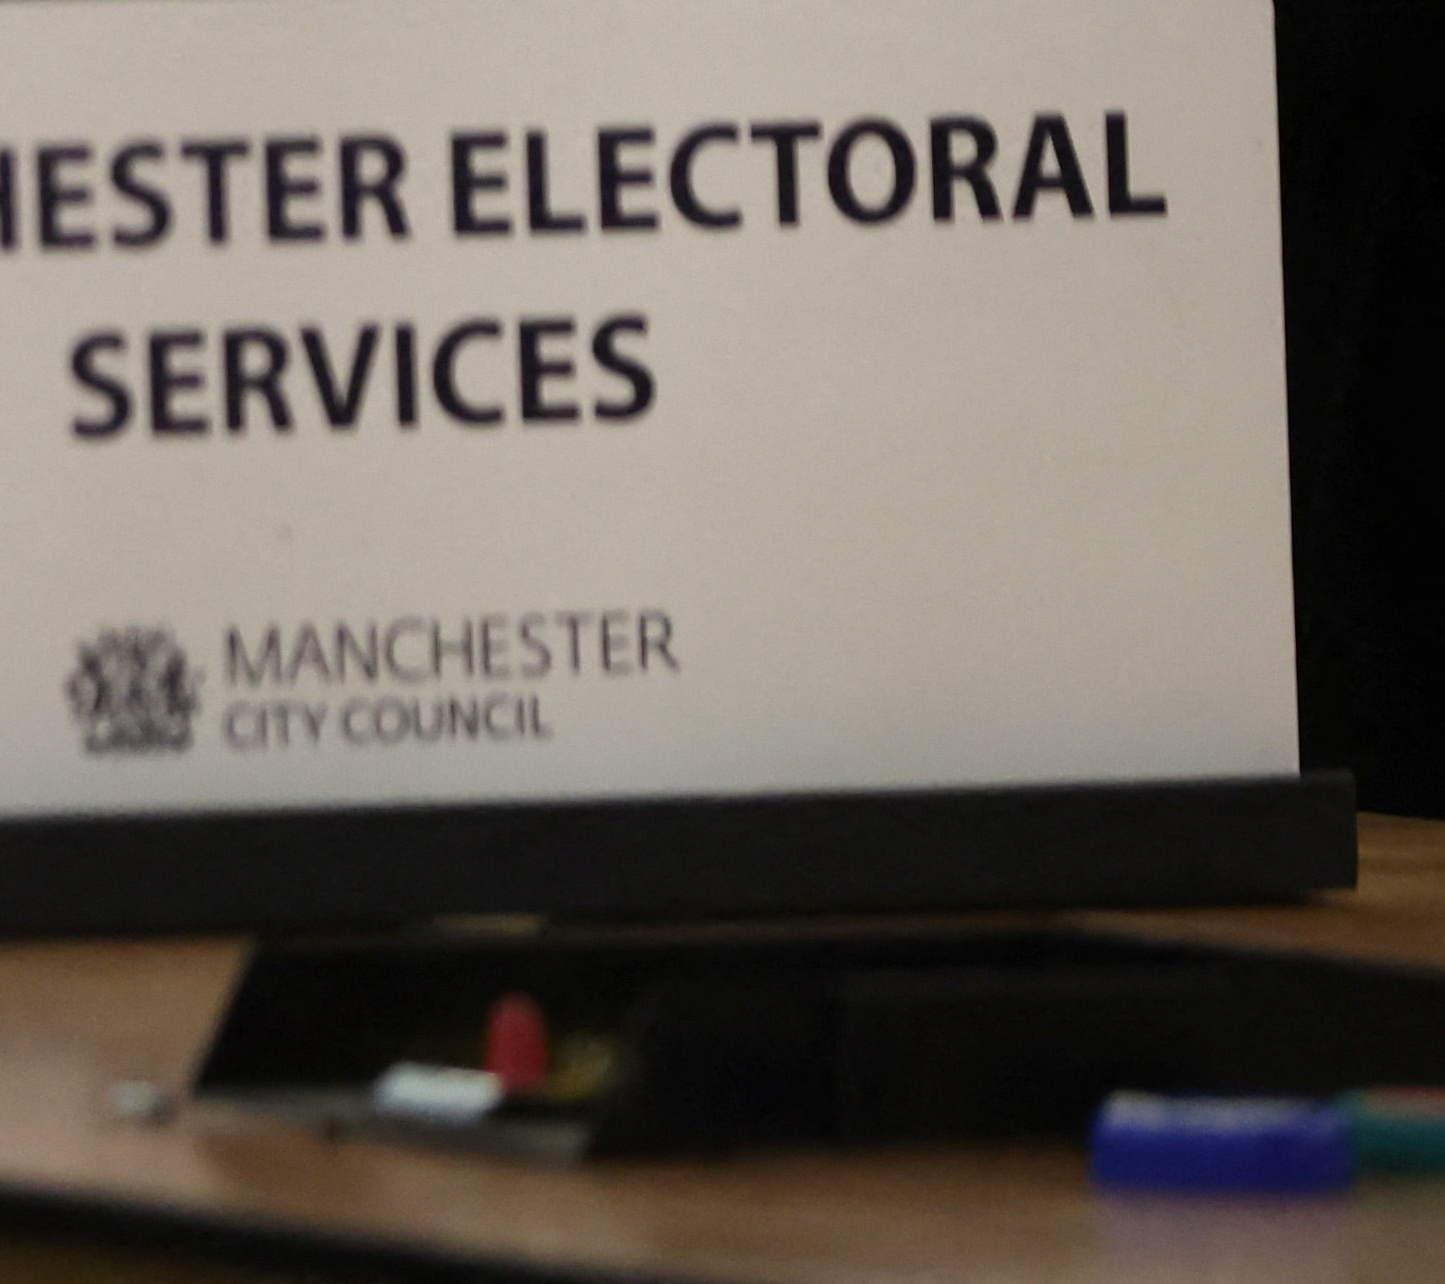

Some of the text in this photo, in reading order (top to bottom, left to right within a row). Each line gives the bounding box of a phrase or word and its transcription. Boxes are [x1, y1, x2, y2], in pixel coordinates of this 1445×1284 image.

[449, 110, 1168, 239] ELECTORAL
[68, 313, 658, 442] SERVICES
[223, 611, 681, 689] MANCHESTER
[223, 694, 550, 749] CITY COUNCIL
